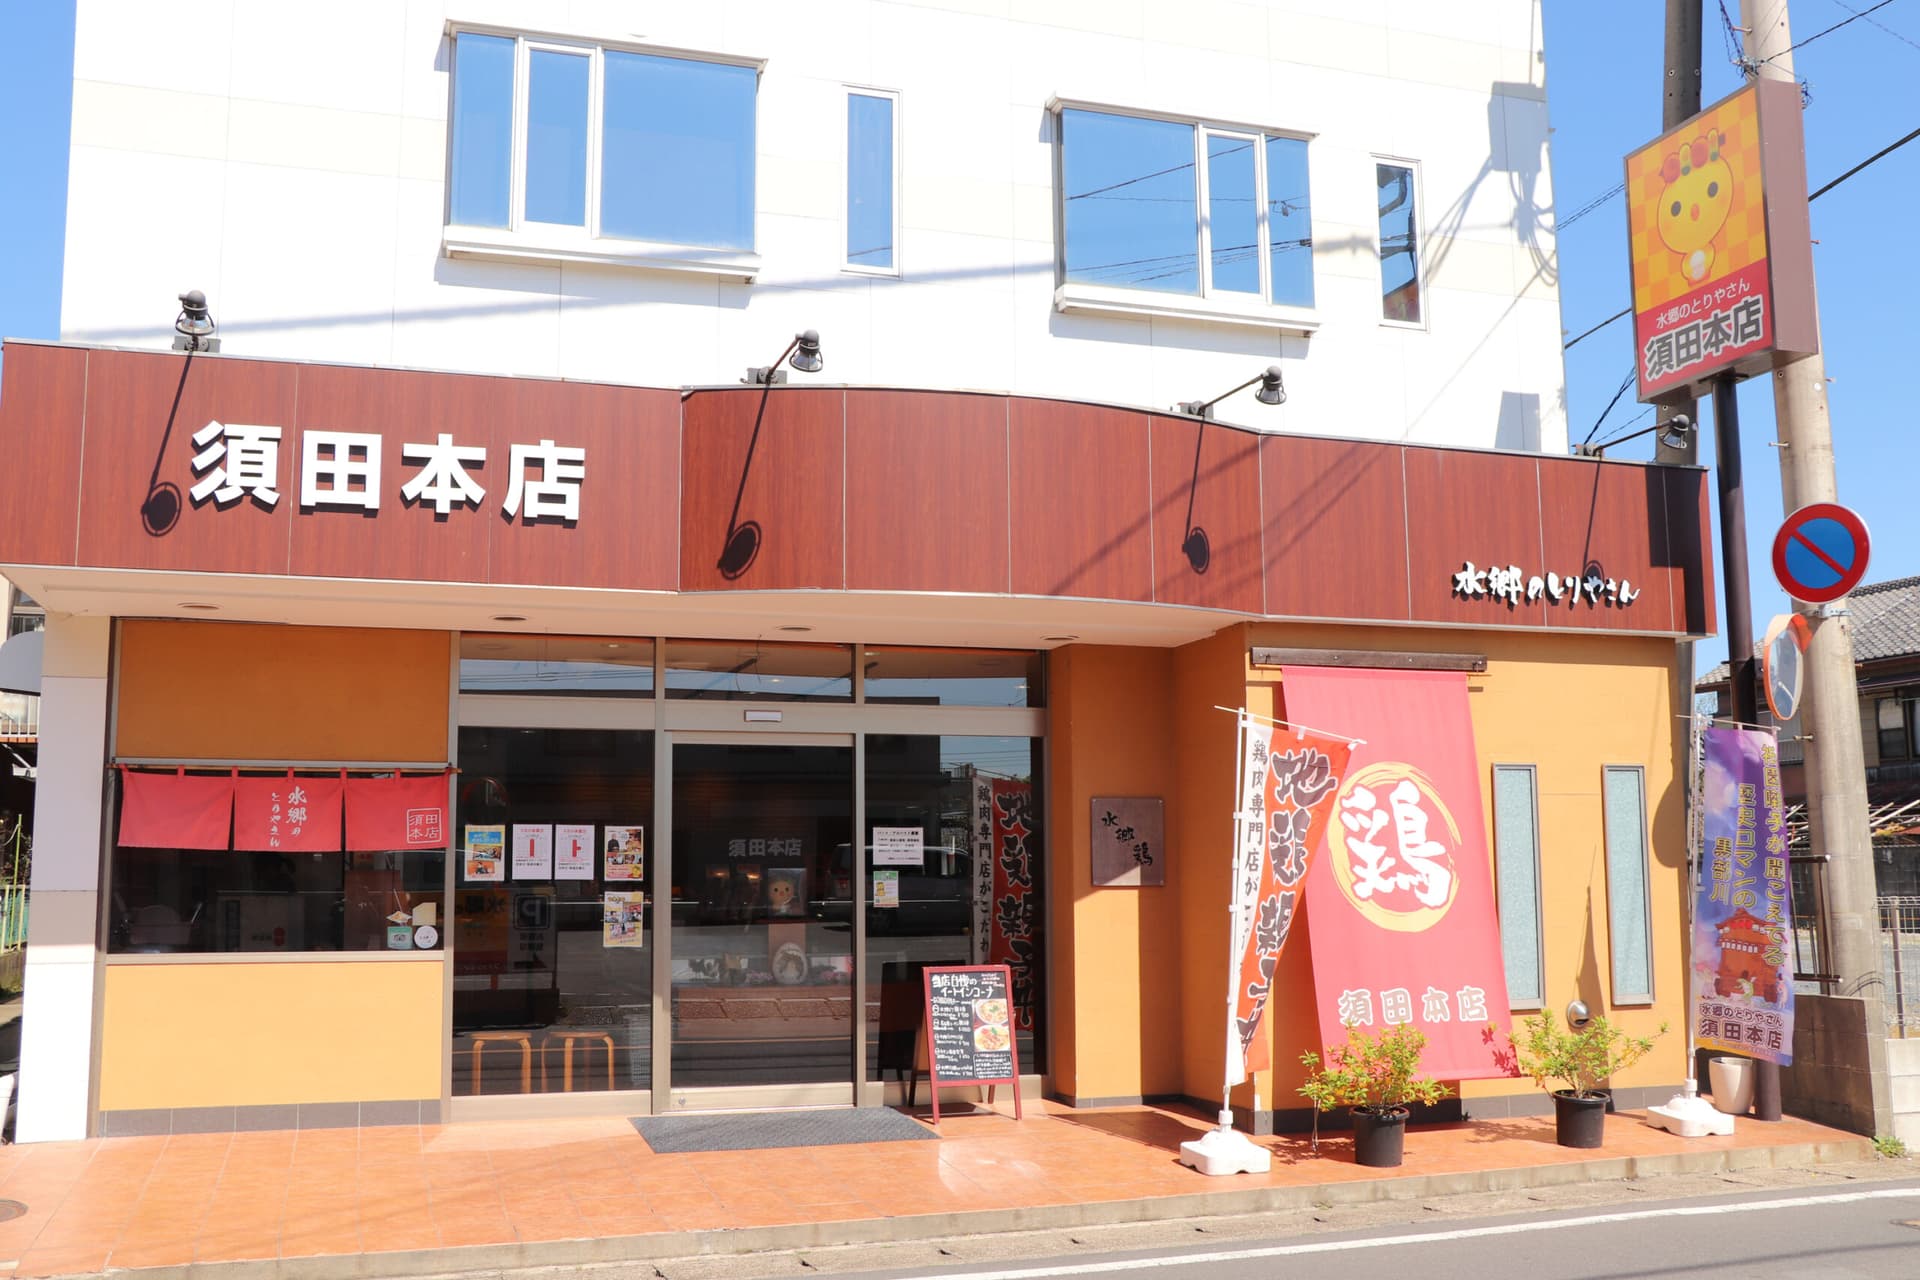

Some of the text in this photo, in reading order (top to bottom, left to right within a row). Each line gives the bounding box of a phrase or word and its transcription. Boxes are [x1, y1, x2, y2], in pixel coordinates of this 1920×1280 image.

[1656, 278, 1750, 330] 水郷のとりやさん
[1645, 296, 1763, 382] 須田本店
[190, 420, 586, 521] 須田本店
[1455, 562, 1640, 604] 水郷のとりやさん
[286, 786, 308, 836] 水郷の
[728, 838, 802, 857] 須田本店
[1340, 779, 1451, 909] 鶏
[1733, 783, 1758, 908] 歴史ロマンの
[977, 785, 993, 965] 鶏肉専門店がこだわ
[1711, 837, 1732, 905] 黒部川
[1338, 986, 1489, 1026] 須田本店
[1699, 1003, 1783, 1028] 水郷のとりやさん
[1699, 1019, 1783, 1050] 須田本店
